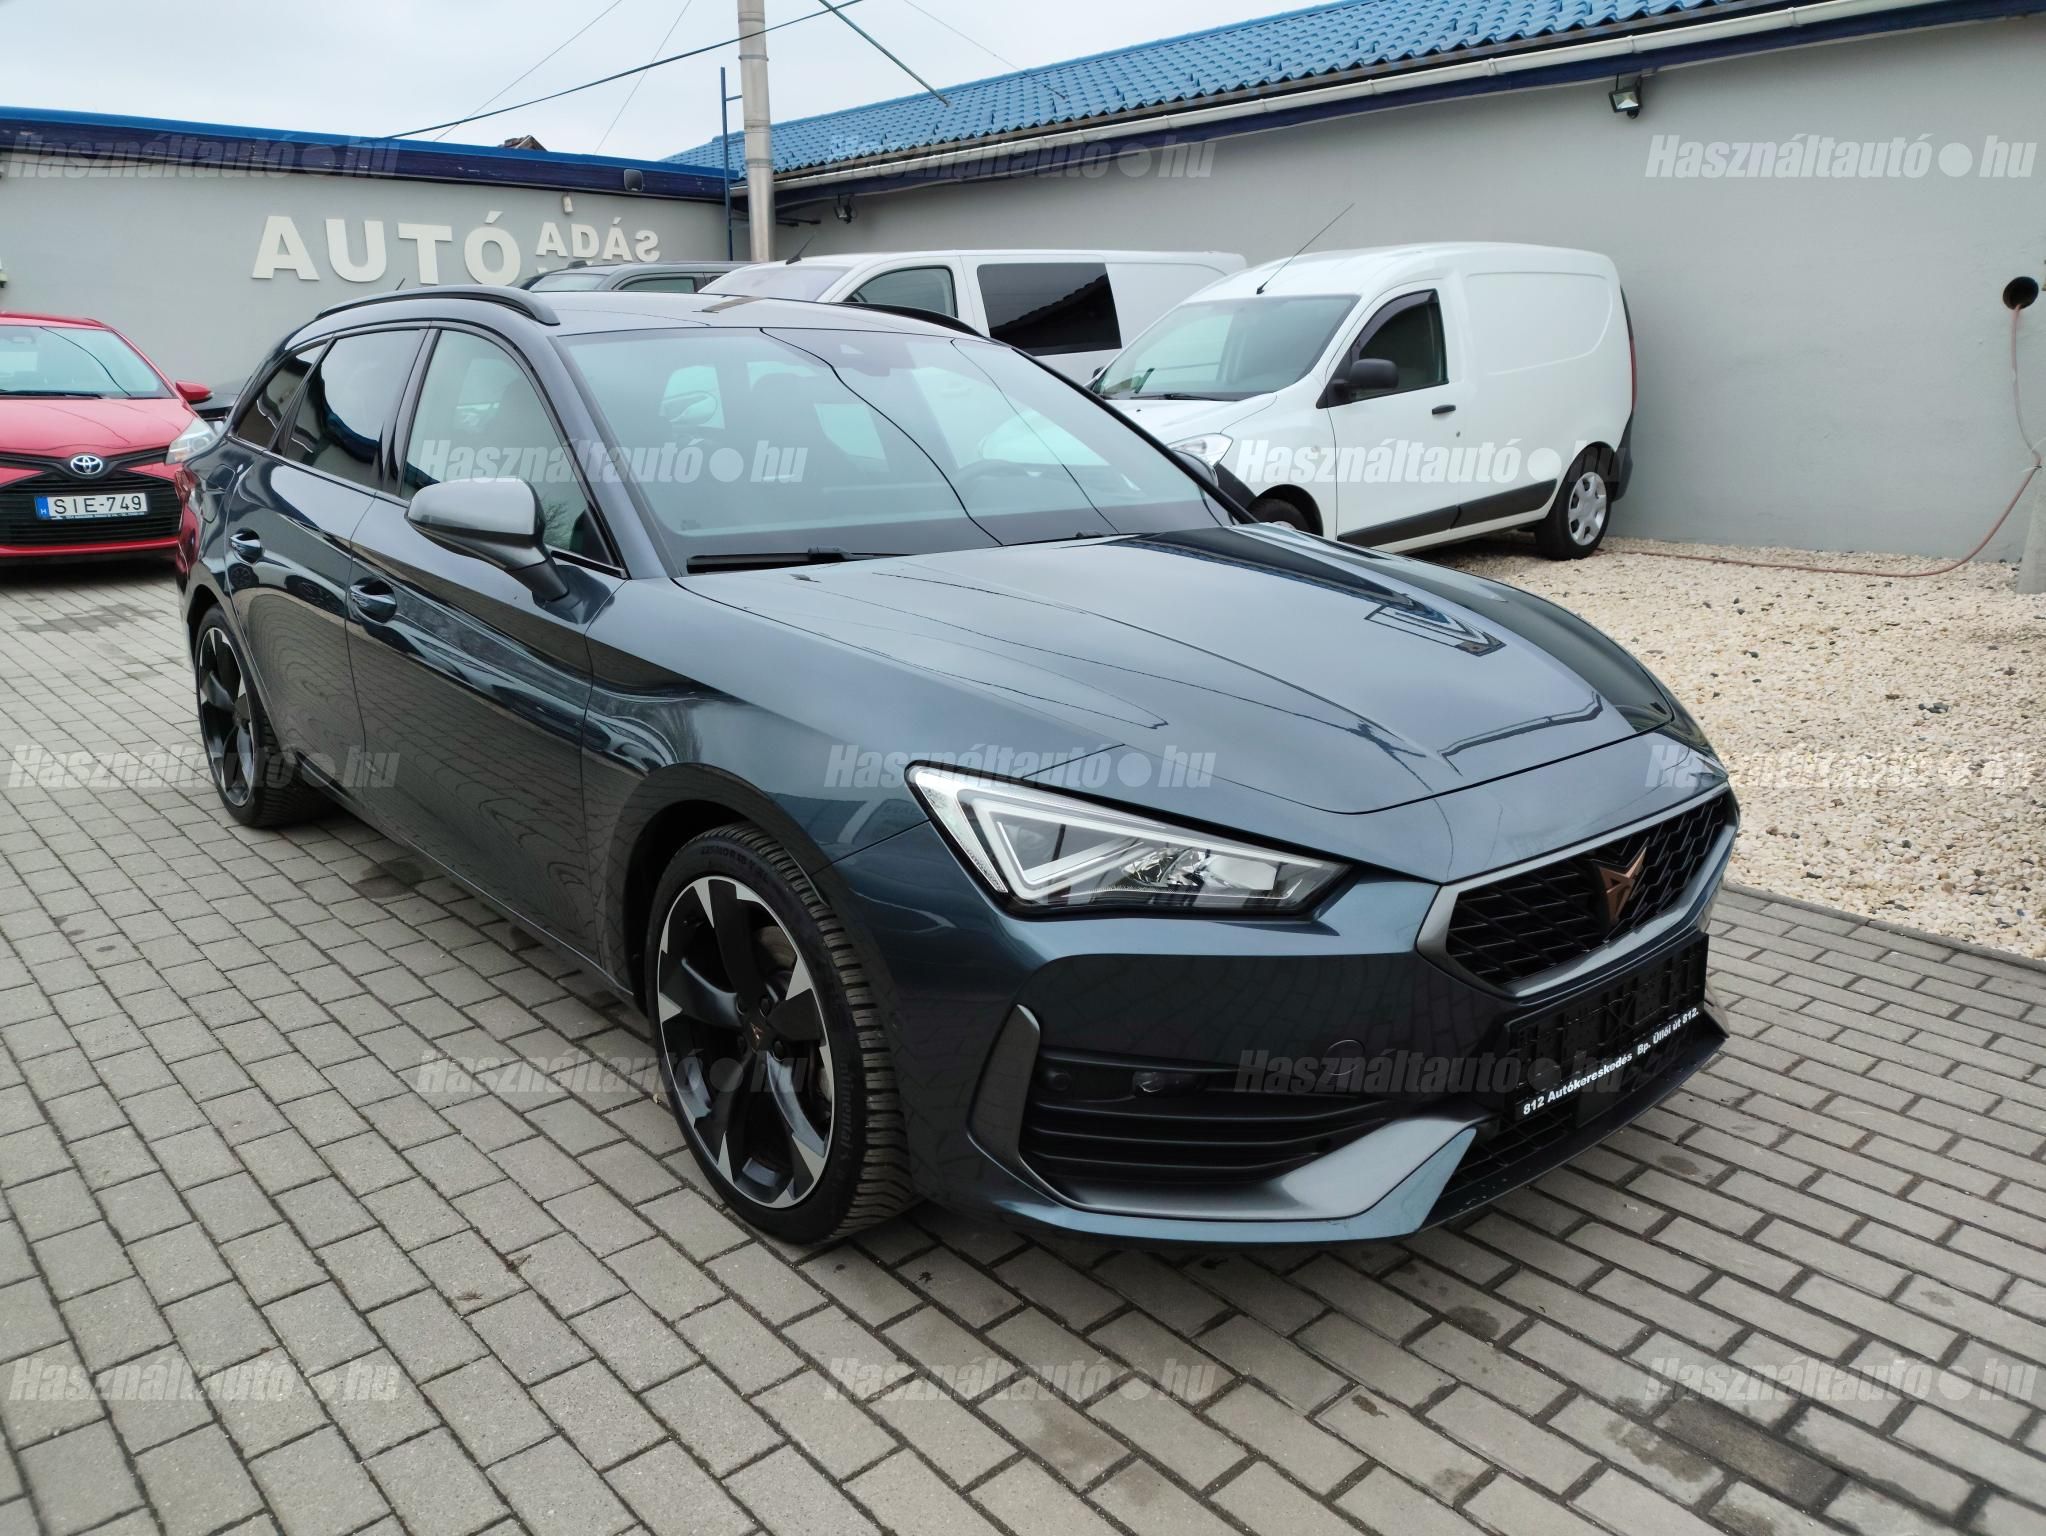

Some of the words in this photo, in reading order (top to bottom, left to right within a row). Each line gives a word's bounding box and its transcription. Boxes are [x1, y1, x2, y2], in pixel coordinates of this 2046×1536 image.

[252, 211, 521, 285] AUTÓ
[54, 495, 142, 514] SIE-749
[1523, 1096, 1545, 1115] 812
[1547, 1052, 1633, 1103] Autókereskedés
[1637, 1042, 1651, 1056] Bp.
[1682, 1007, 1699, 1024] 812.
